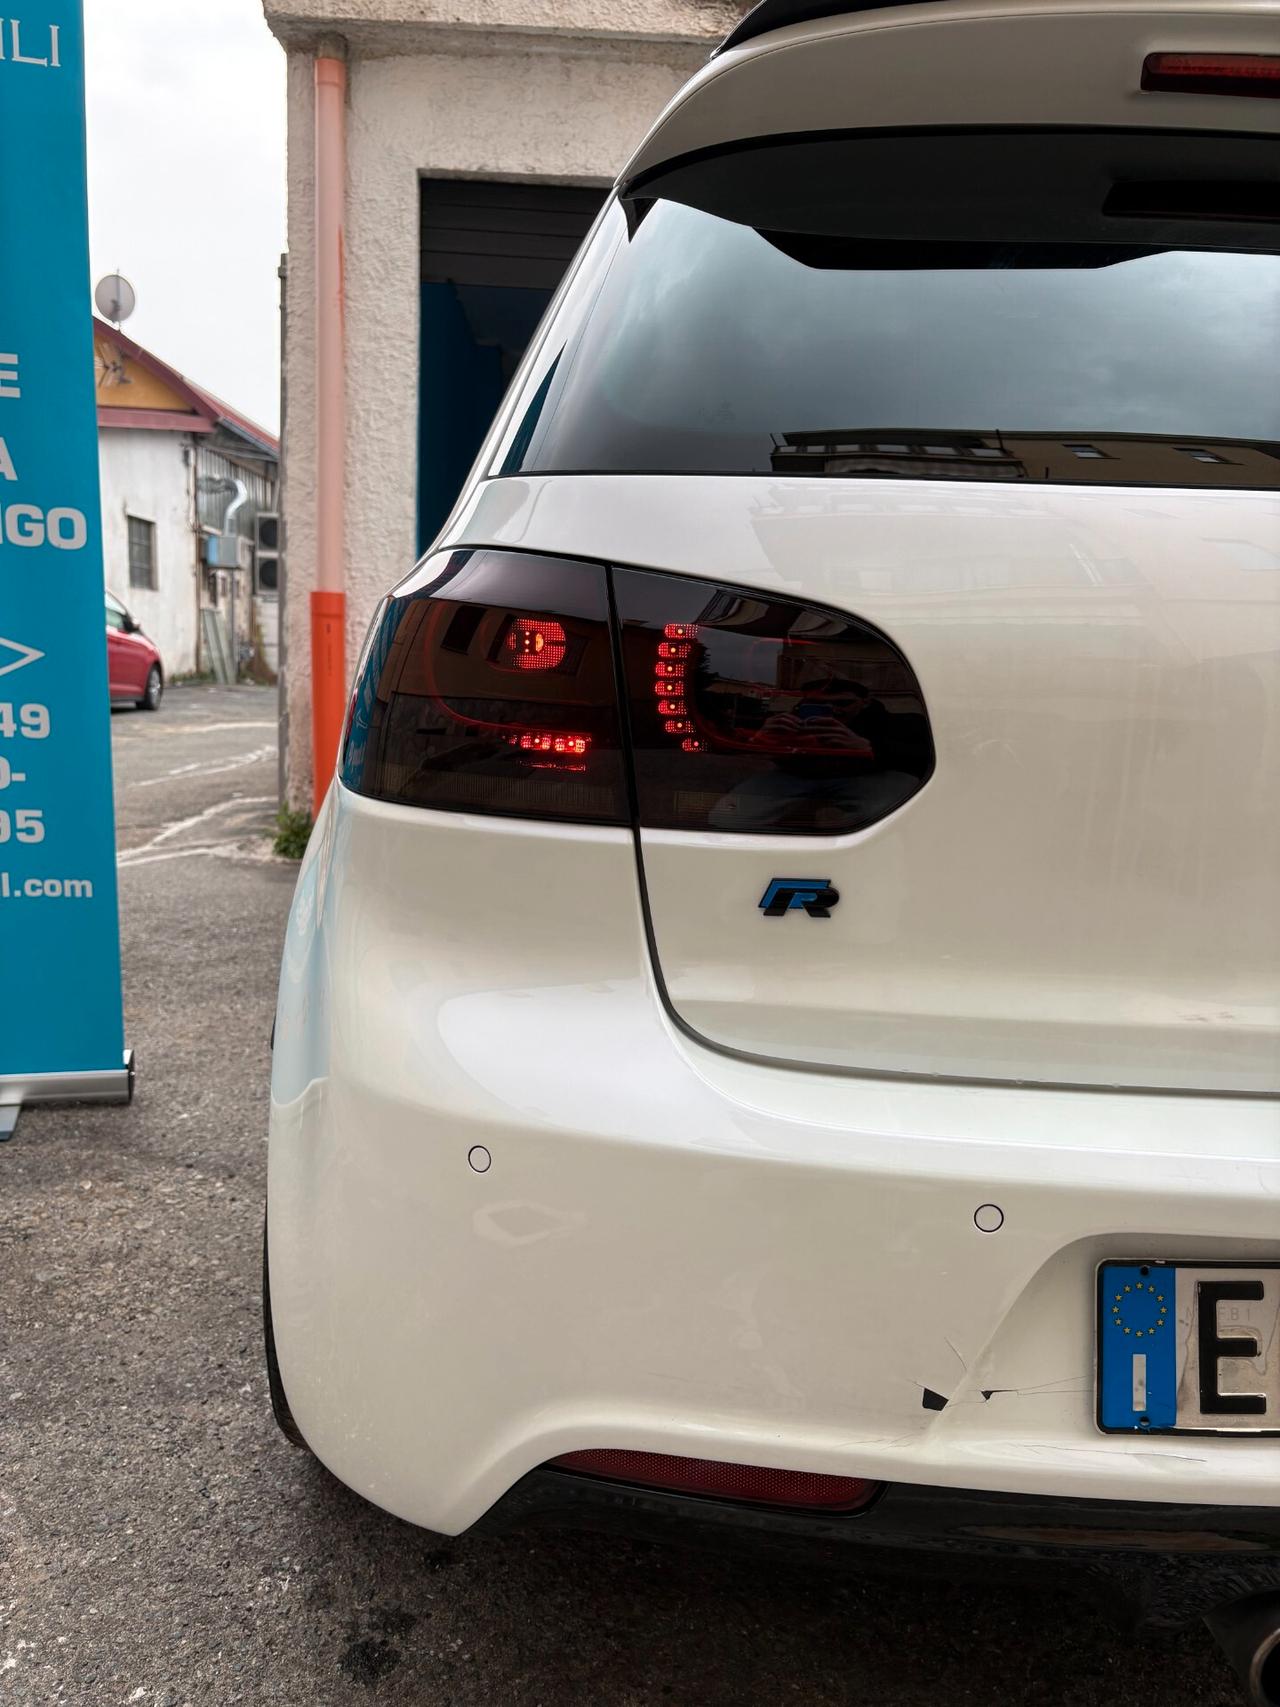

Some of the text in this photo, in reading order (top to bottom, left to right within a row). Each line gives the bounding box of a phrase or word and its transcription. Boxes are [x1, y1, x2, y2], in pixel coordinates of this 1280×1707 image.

[1, 872, 93, 898] l.com
[758, 877, 840, 918] R
[1197, 1280, 1267, 1415] E
